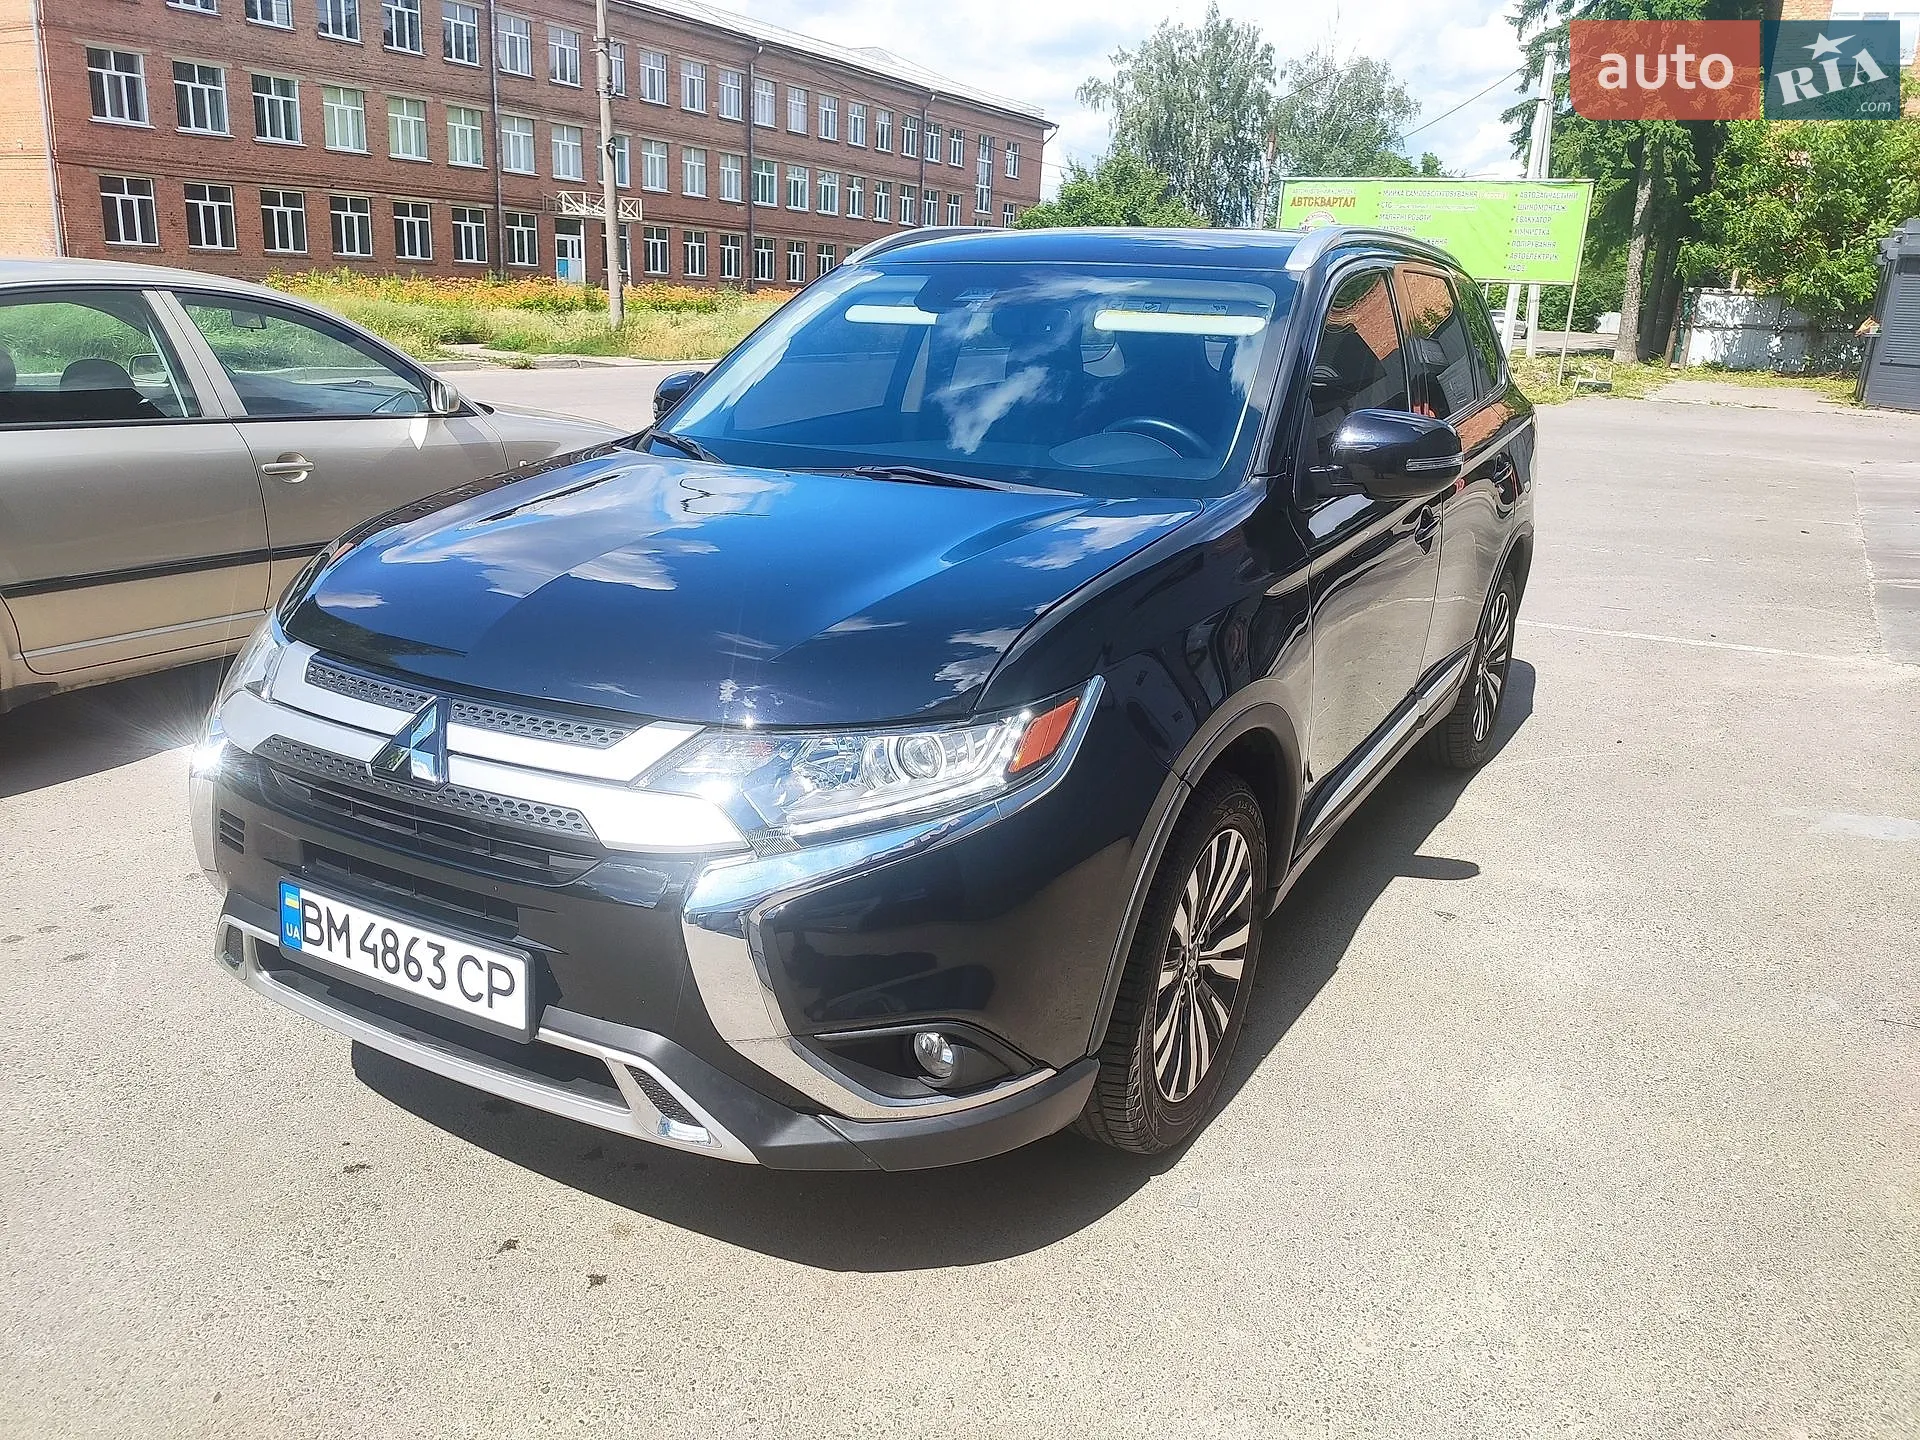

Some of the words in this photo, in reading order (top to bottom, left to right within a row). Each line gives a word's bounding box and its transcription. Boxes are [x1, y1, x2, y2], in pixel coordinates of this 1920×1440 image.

[1290, 196, 1357, 208] АВТОКВАРТАЛ
[285, 925, 300, 939] UA
[301, 898, 351, 958] BM
[359, 922, 447, 990] 4863
[457, 954, 515, 1009] CP
